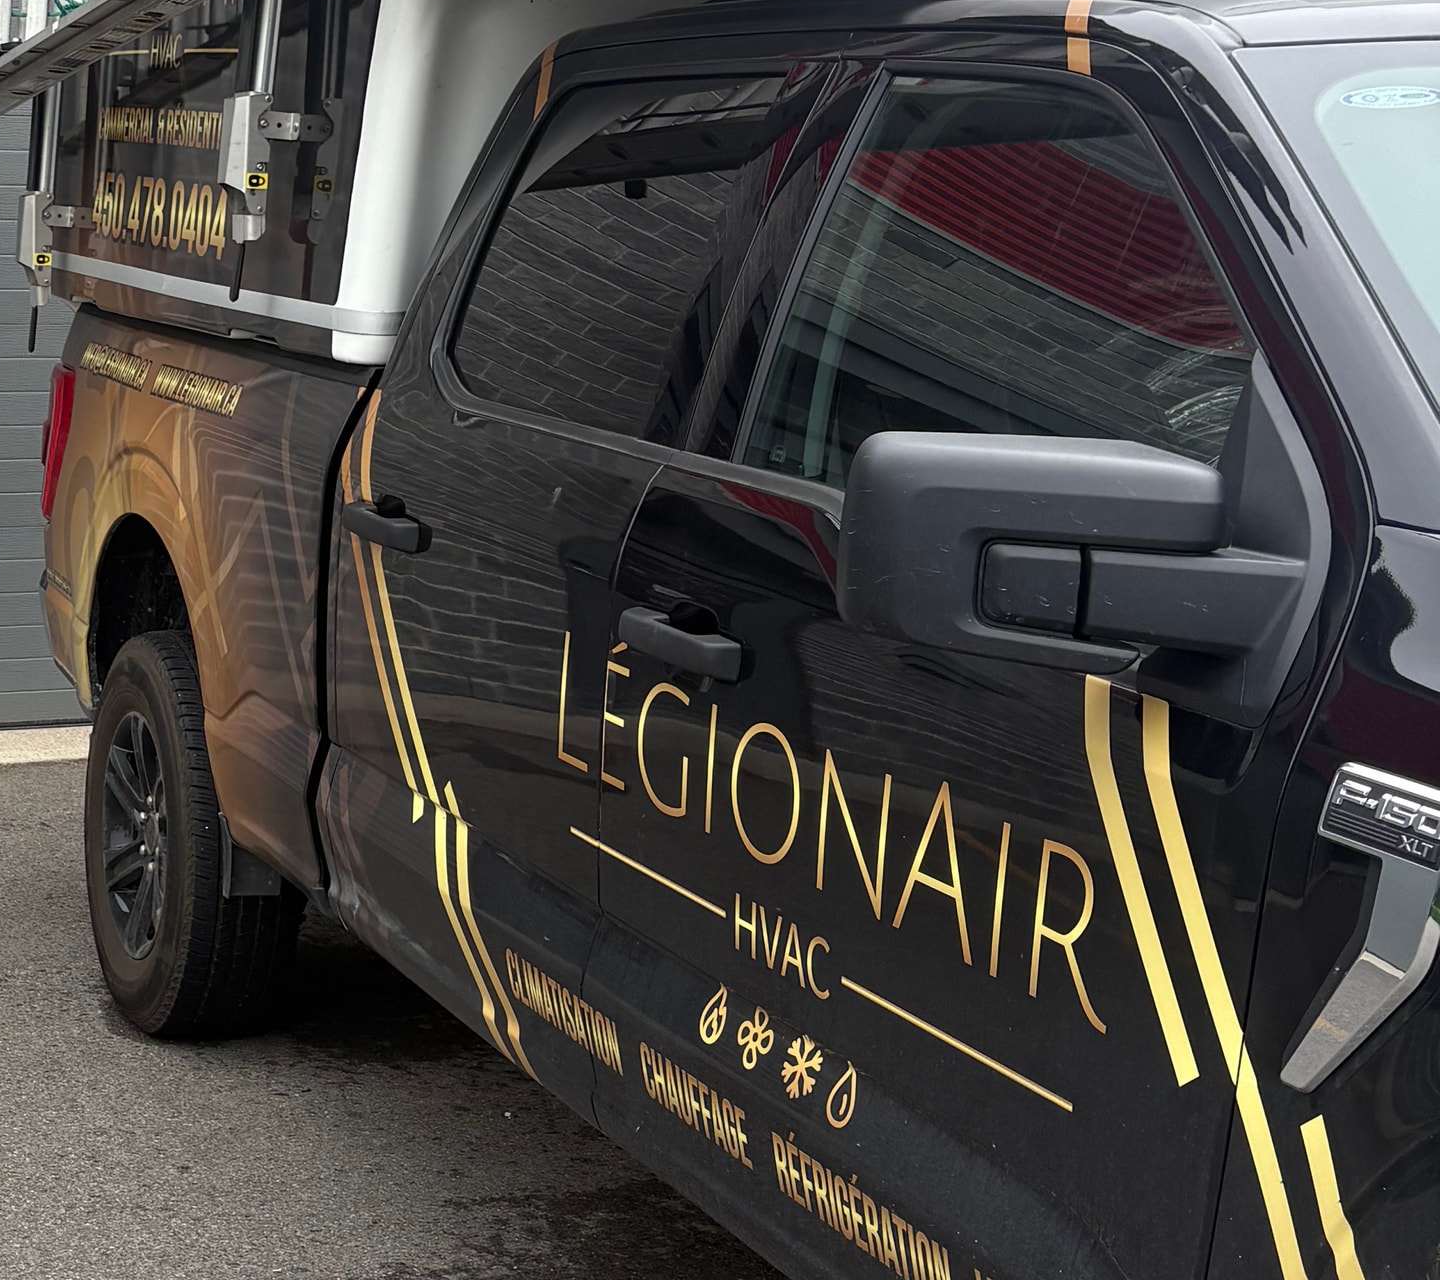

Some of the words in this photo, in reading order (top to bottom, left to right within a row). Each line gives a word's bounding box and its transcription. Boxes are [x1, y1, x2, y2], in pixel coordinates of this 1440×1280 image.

[149, 33, 182, 69] HVAC
[98, 106, 154, 144] COMMERCIAL
[156, 107, 165, 145] &
[165, 102, 223, 151] RÉSIDENTI
[91, 172, 228, 261] 450.478.0404
[151, 364, 244, 417] WWW.LEGIONAIR.CA
[557, 630, 1108, 1035] LÉGIONAIR
[1397, 834, 1434, 858] XLT
[733, 892, 831, 1001] HVAC
[504, 947, 624, 1077] CLIMATISATION
[639, 1041, 754, 1171] CHAUFFAGE
